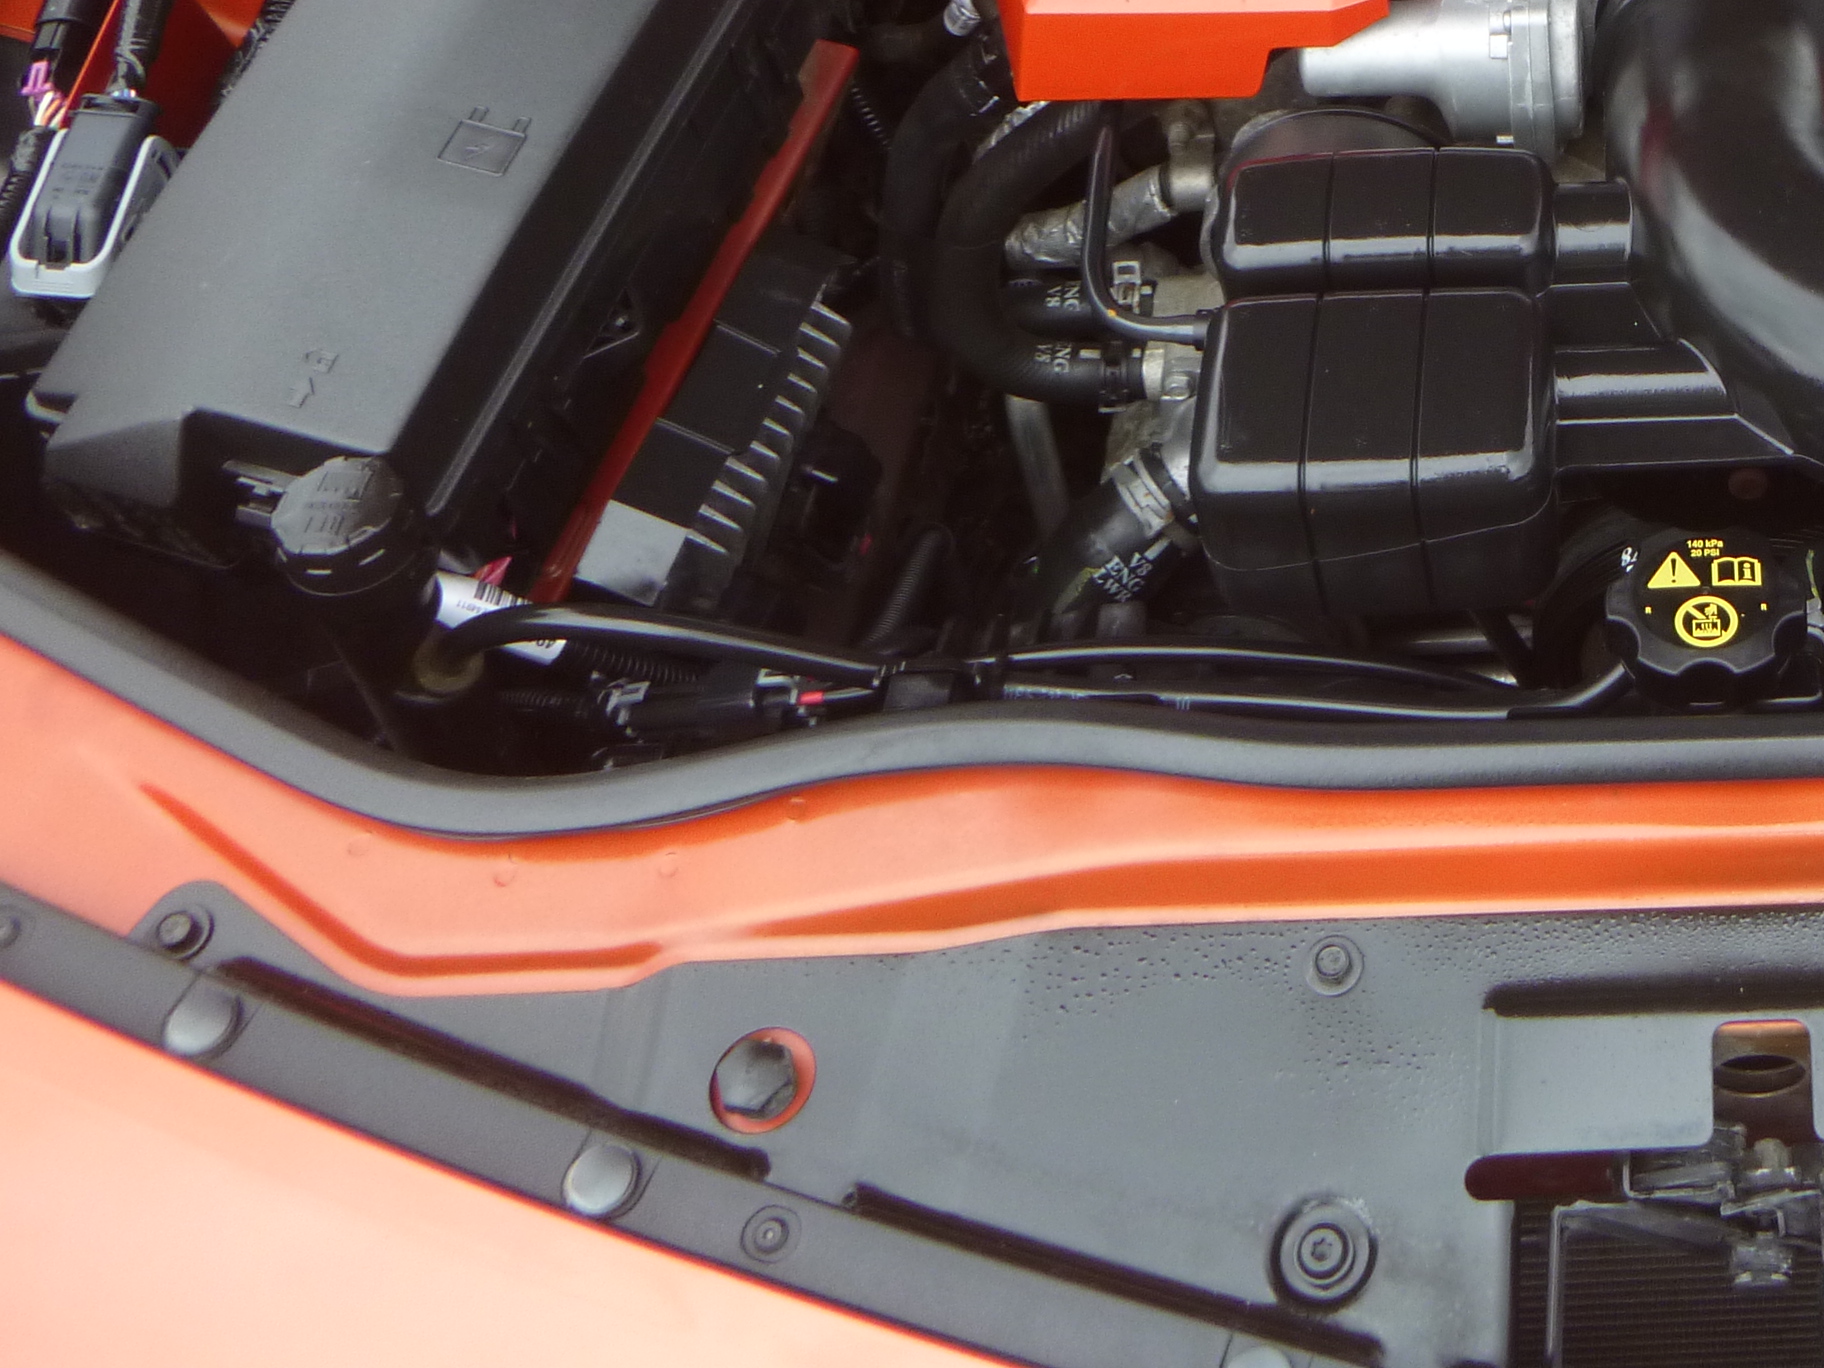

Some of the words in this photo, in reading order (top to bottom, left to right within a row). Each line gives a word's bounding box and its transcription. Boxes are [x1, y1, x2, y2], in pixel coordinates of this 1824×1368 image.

[1687, 540, 1703, 548] 140
[1705, 539, 1723, 548] kPa
[1690, 549, 1702, 557] 20
[1704, 549, 1720, 557] PSI
